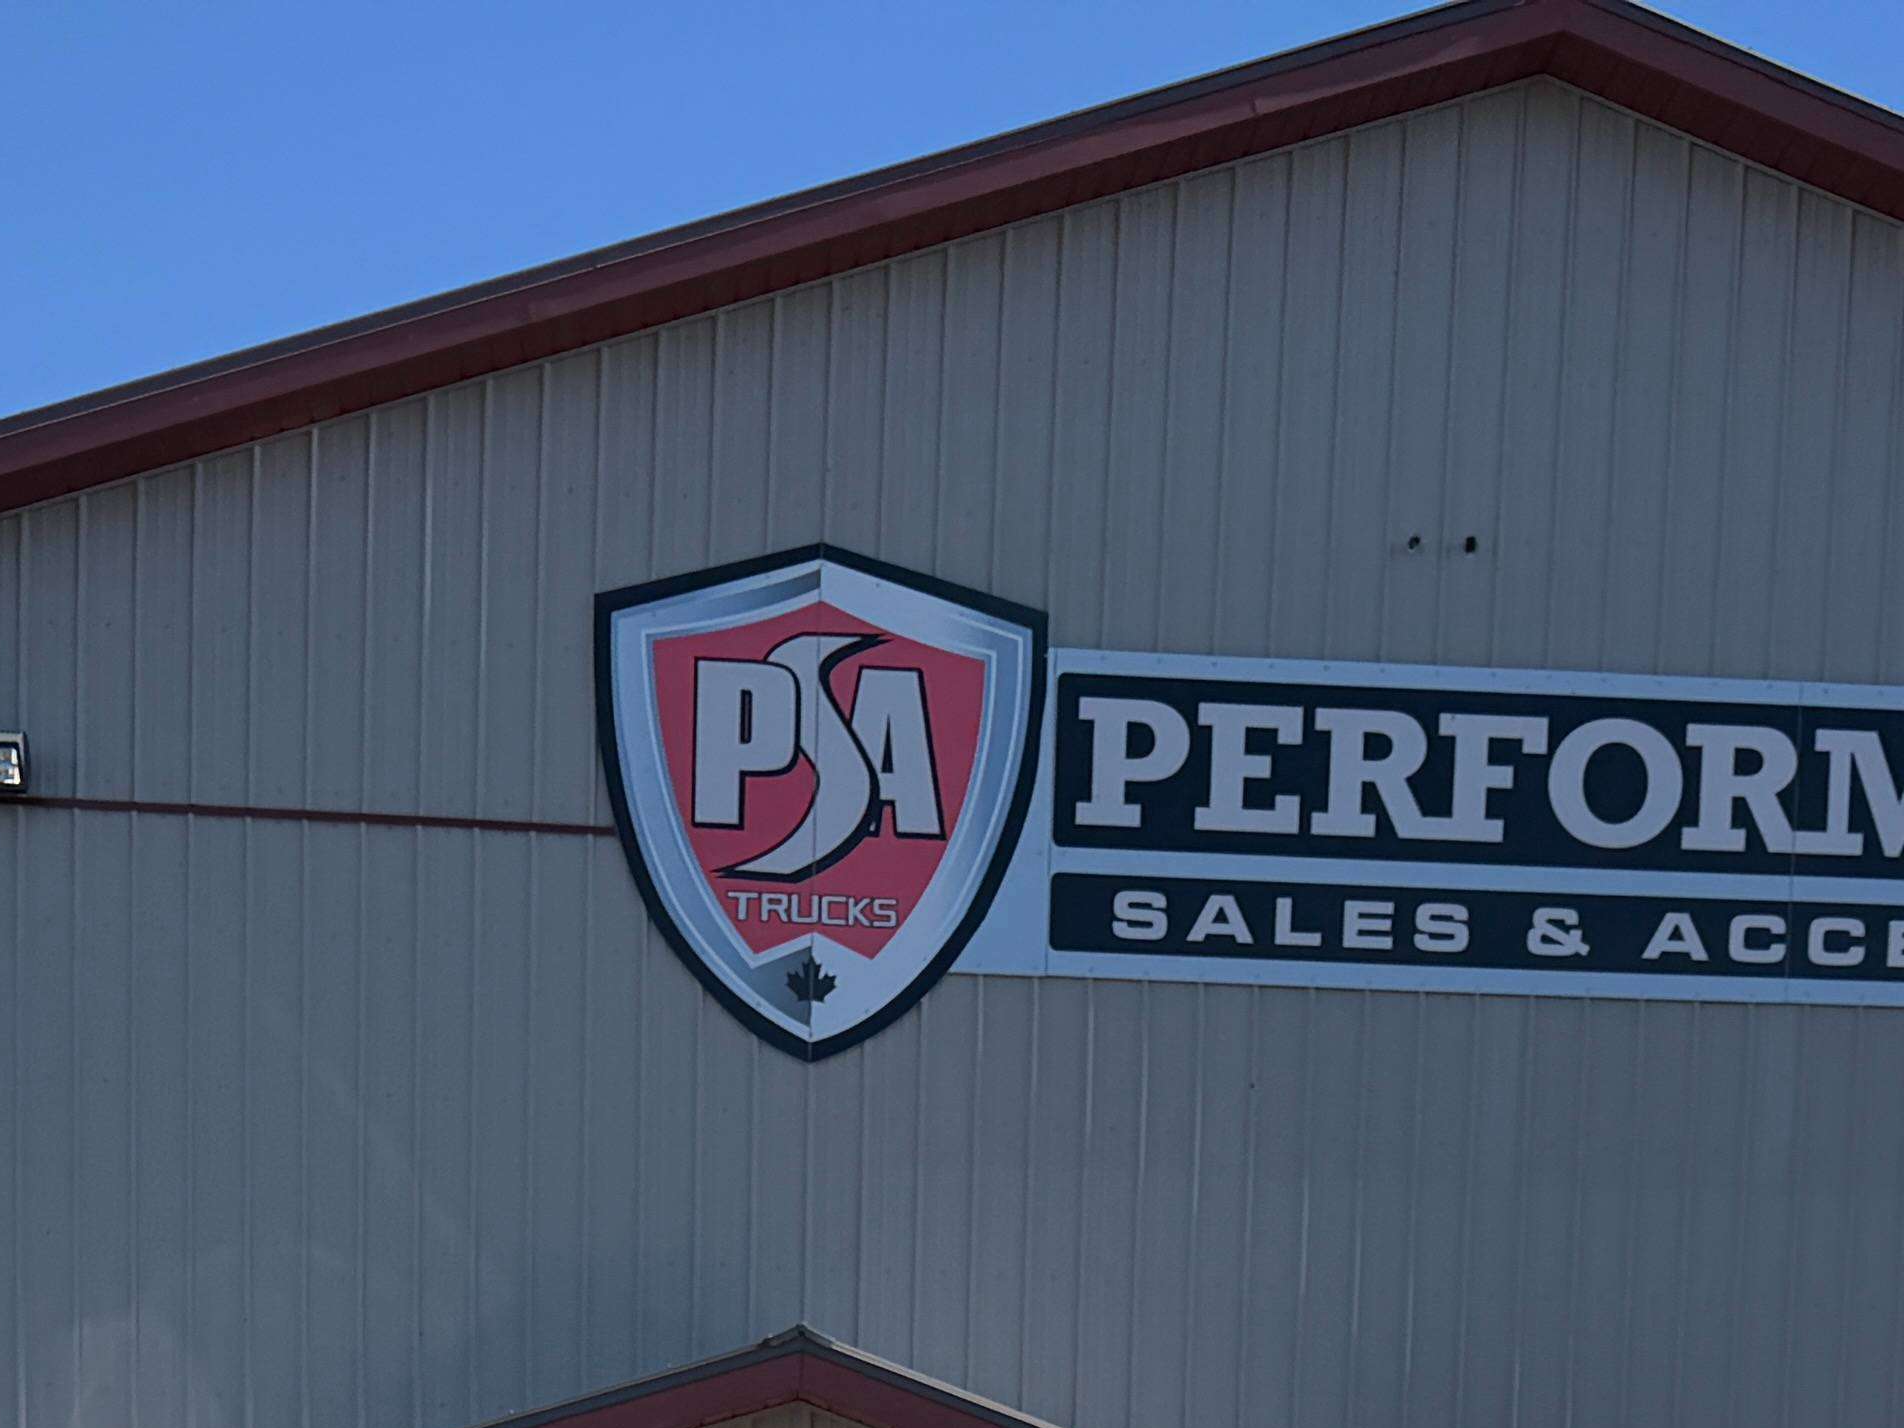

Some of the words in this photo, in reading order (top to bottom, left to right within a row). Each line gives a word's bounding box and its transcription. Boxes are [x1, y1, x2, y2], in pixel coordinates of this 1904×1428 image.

[692, 631, 947, 883] PSA
[727, 890, 899, 929] TRUCKS
[1112, 890, 1469, 954] SALES
[1525, 907, 1590, 957] &
